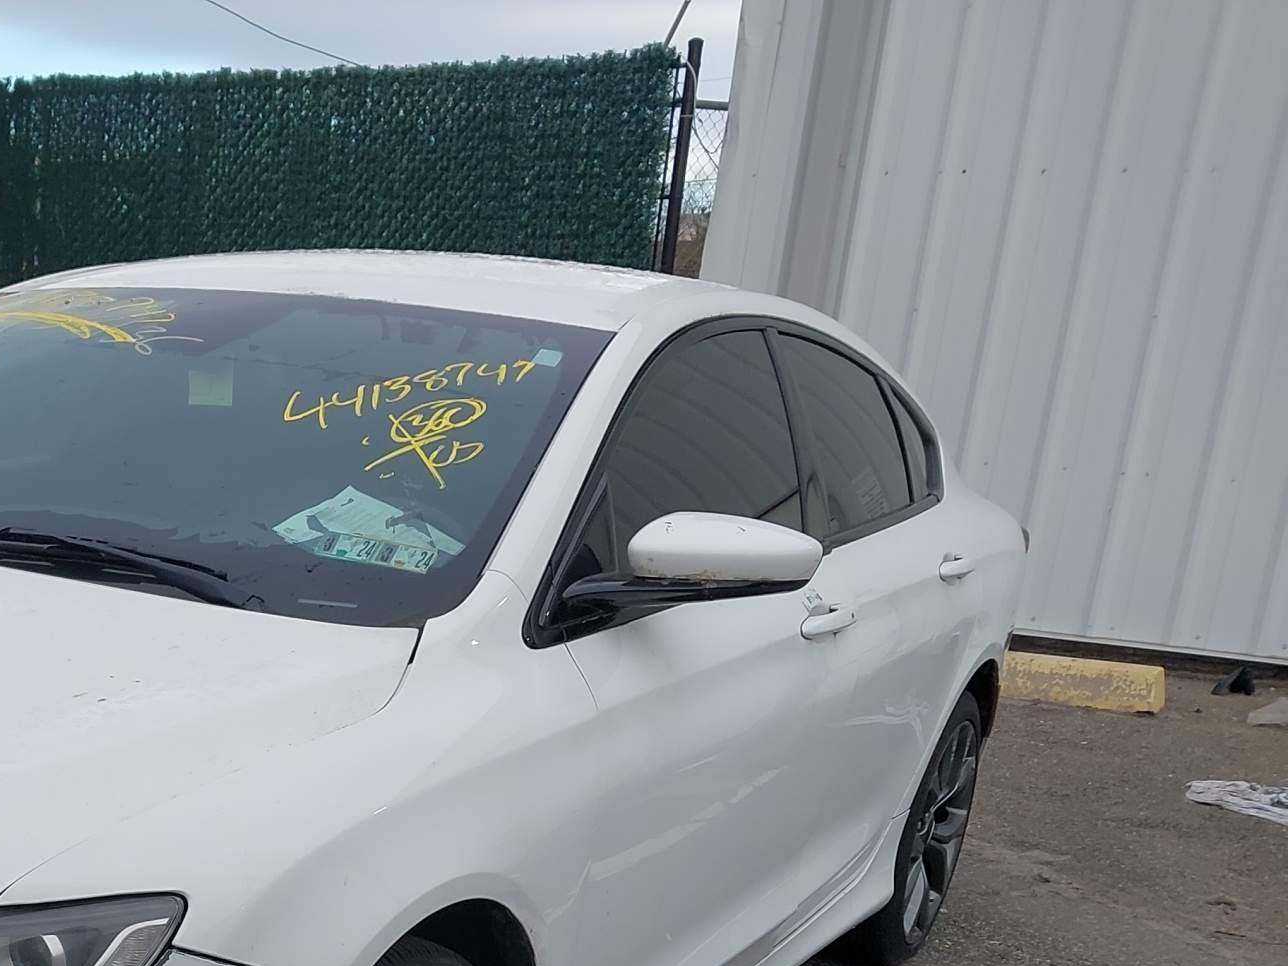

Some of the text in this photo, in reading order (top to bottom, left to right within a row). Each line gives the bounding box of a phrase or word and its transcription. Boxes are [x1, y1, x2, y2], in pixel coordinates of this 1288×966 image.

[283, 359, 536, 429] 44138747
[356, 540, 377, 558] 24
[415, 551, 434, 570] 24
